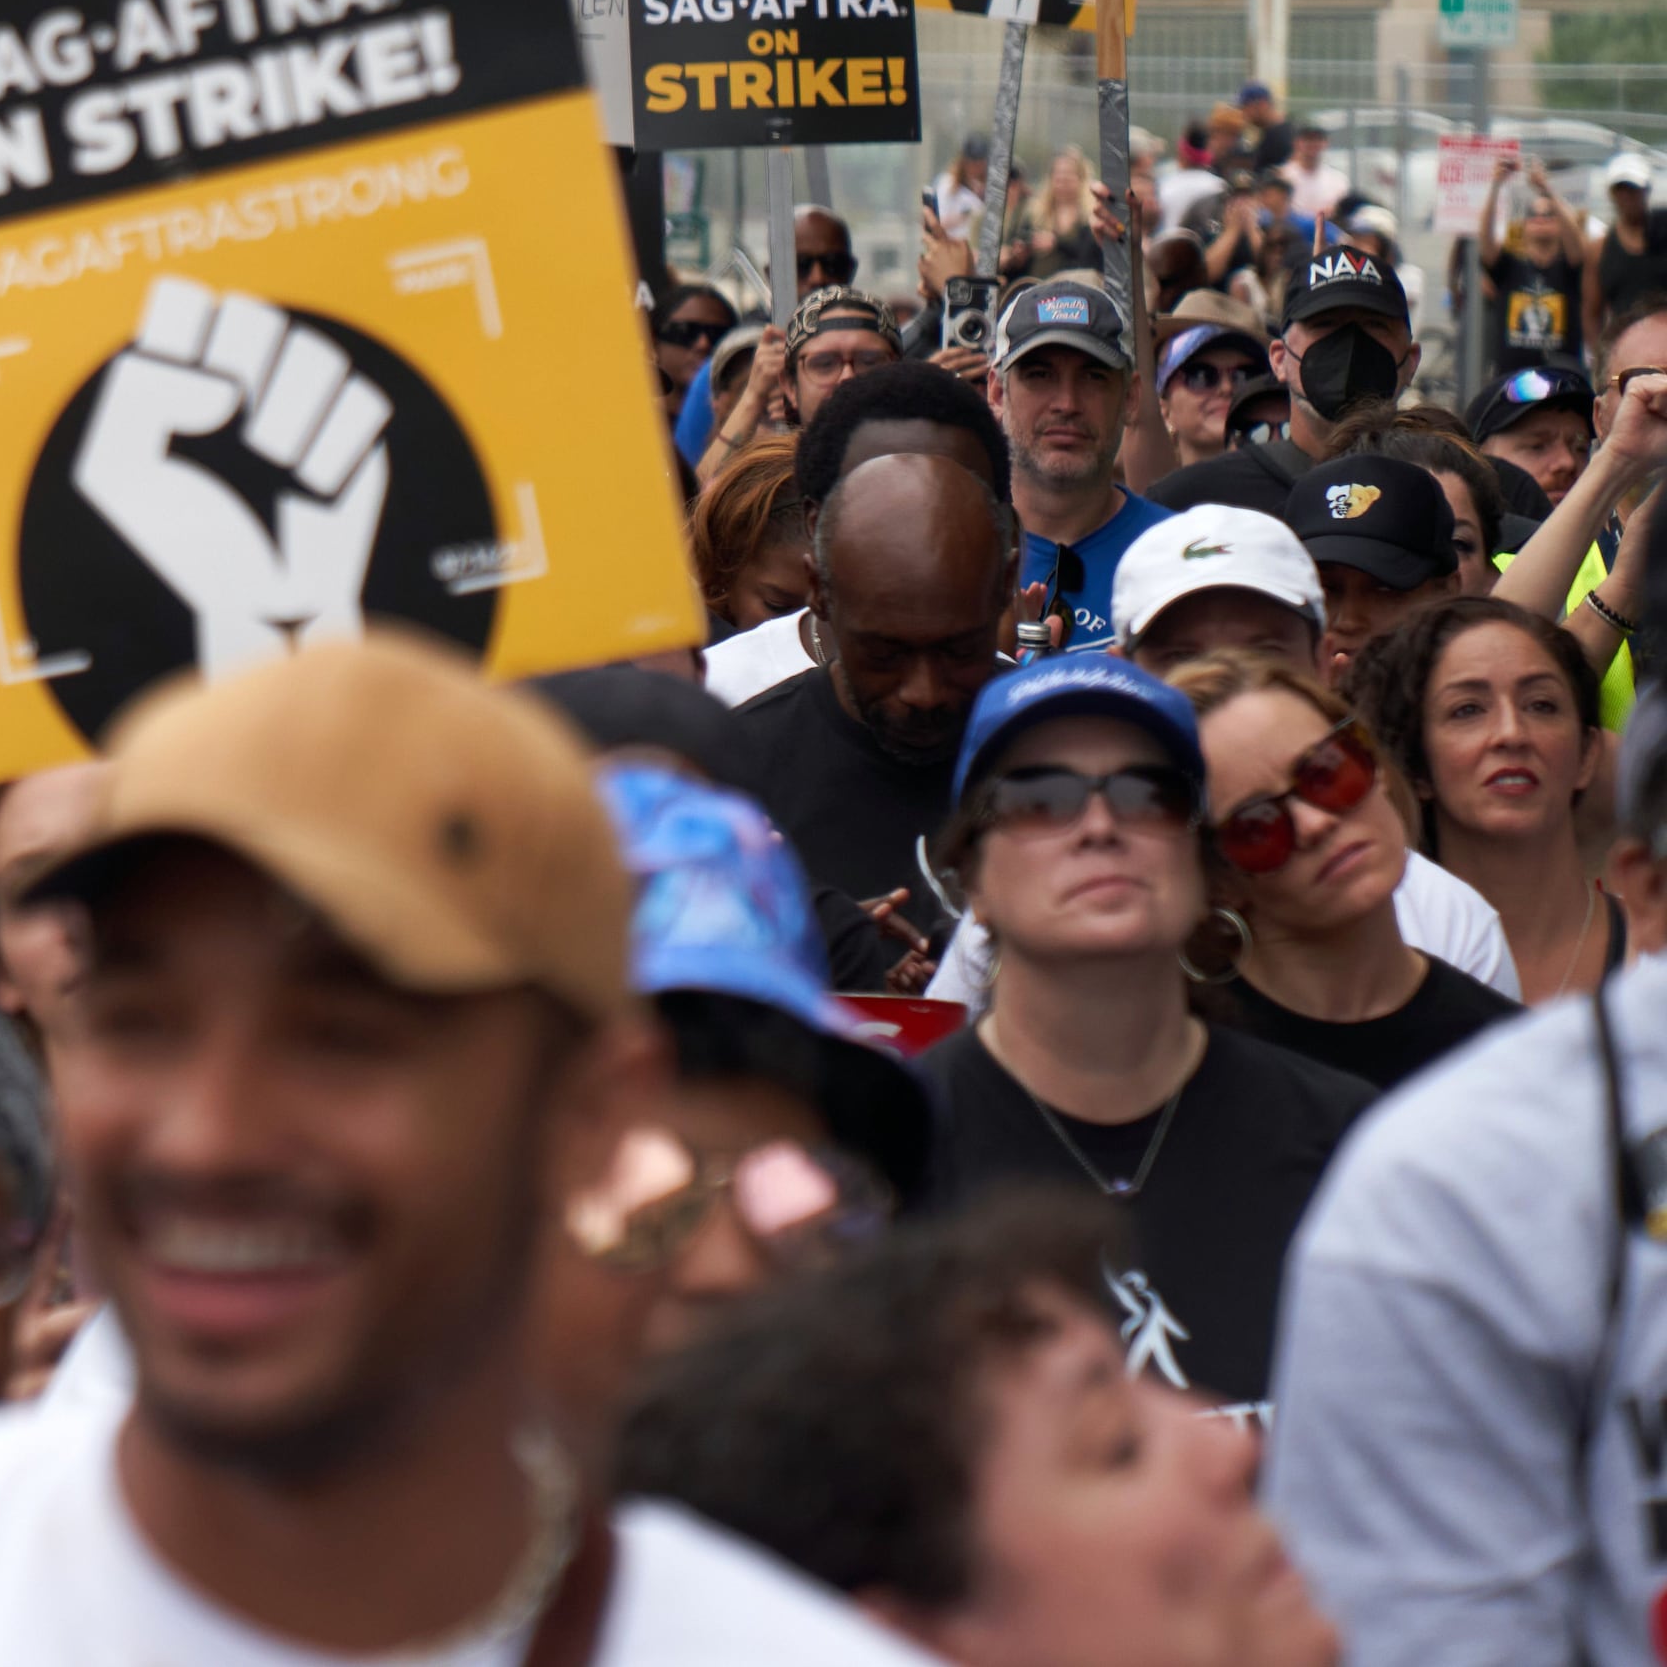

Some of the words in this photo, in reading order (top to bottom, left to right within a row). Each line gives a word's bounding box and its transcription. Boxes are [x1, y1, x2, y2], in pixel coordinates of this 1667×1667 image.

[747, 29, 799, 55] ON
[69, 8, 465, 179] STRIKE!
[645, 57, 908, 114] STRIKE!
[1310, 250, 1383, 286] NAVA
[1074, 606, 1107, 634] OF
